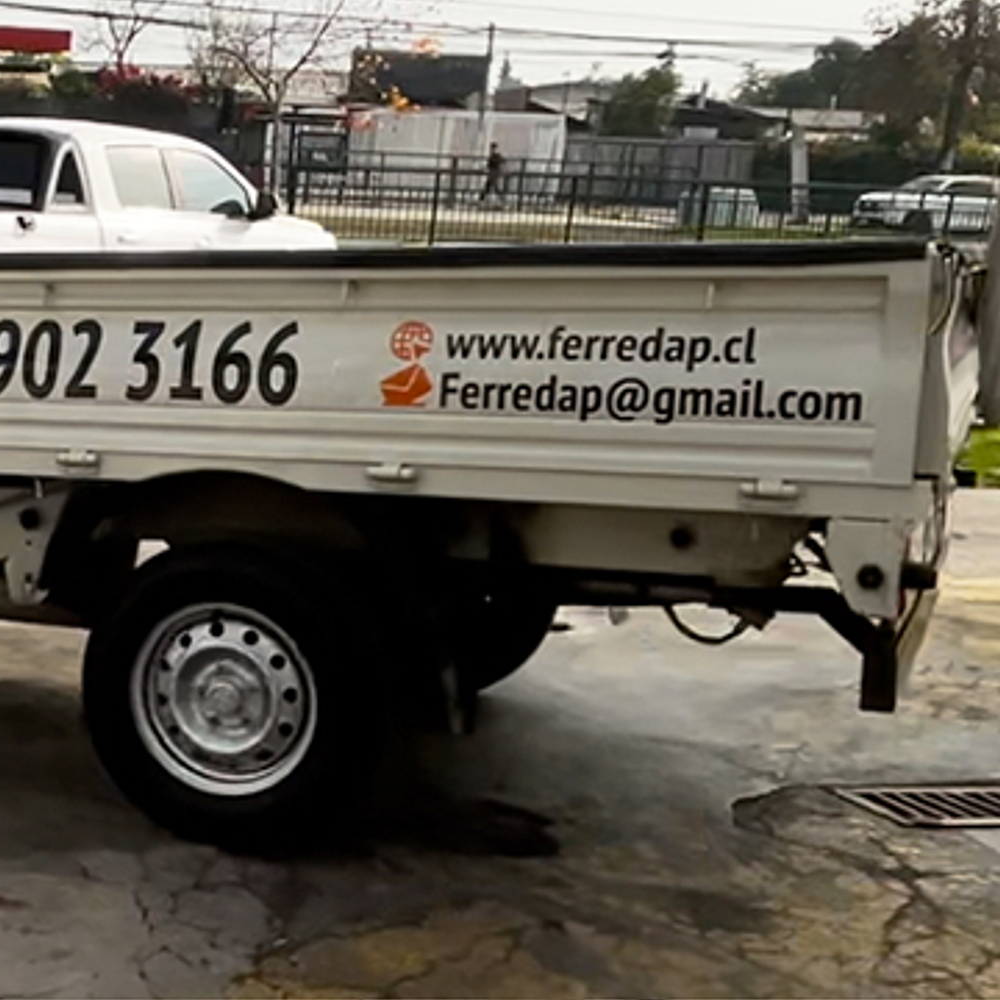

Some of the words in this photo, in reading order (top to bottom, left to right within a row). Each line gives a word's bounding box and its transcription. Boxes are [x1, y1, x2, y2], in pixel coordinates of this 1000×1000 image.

[125, 319, 300, 406] 3166
[446, 325, 757, 371] www.ferredap.cl
[439, 372, 863, 424] Ferredap@gmail.com
